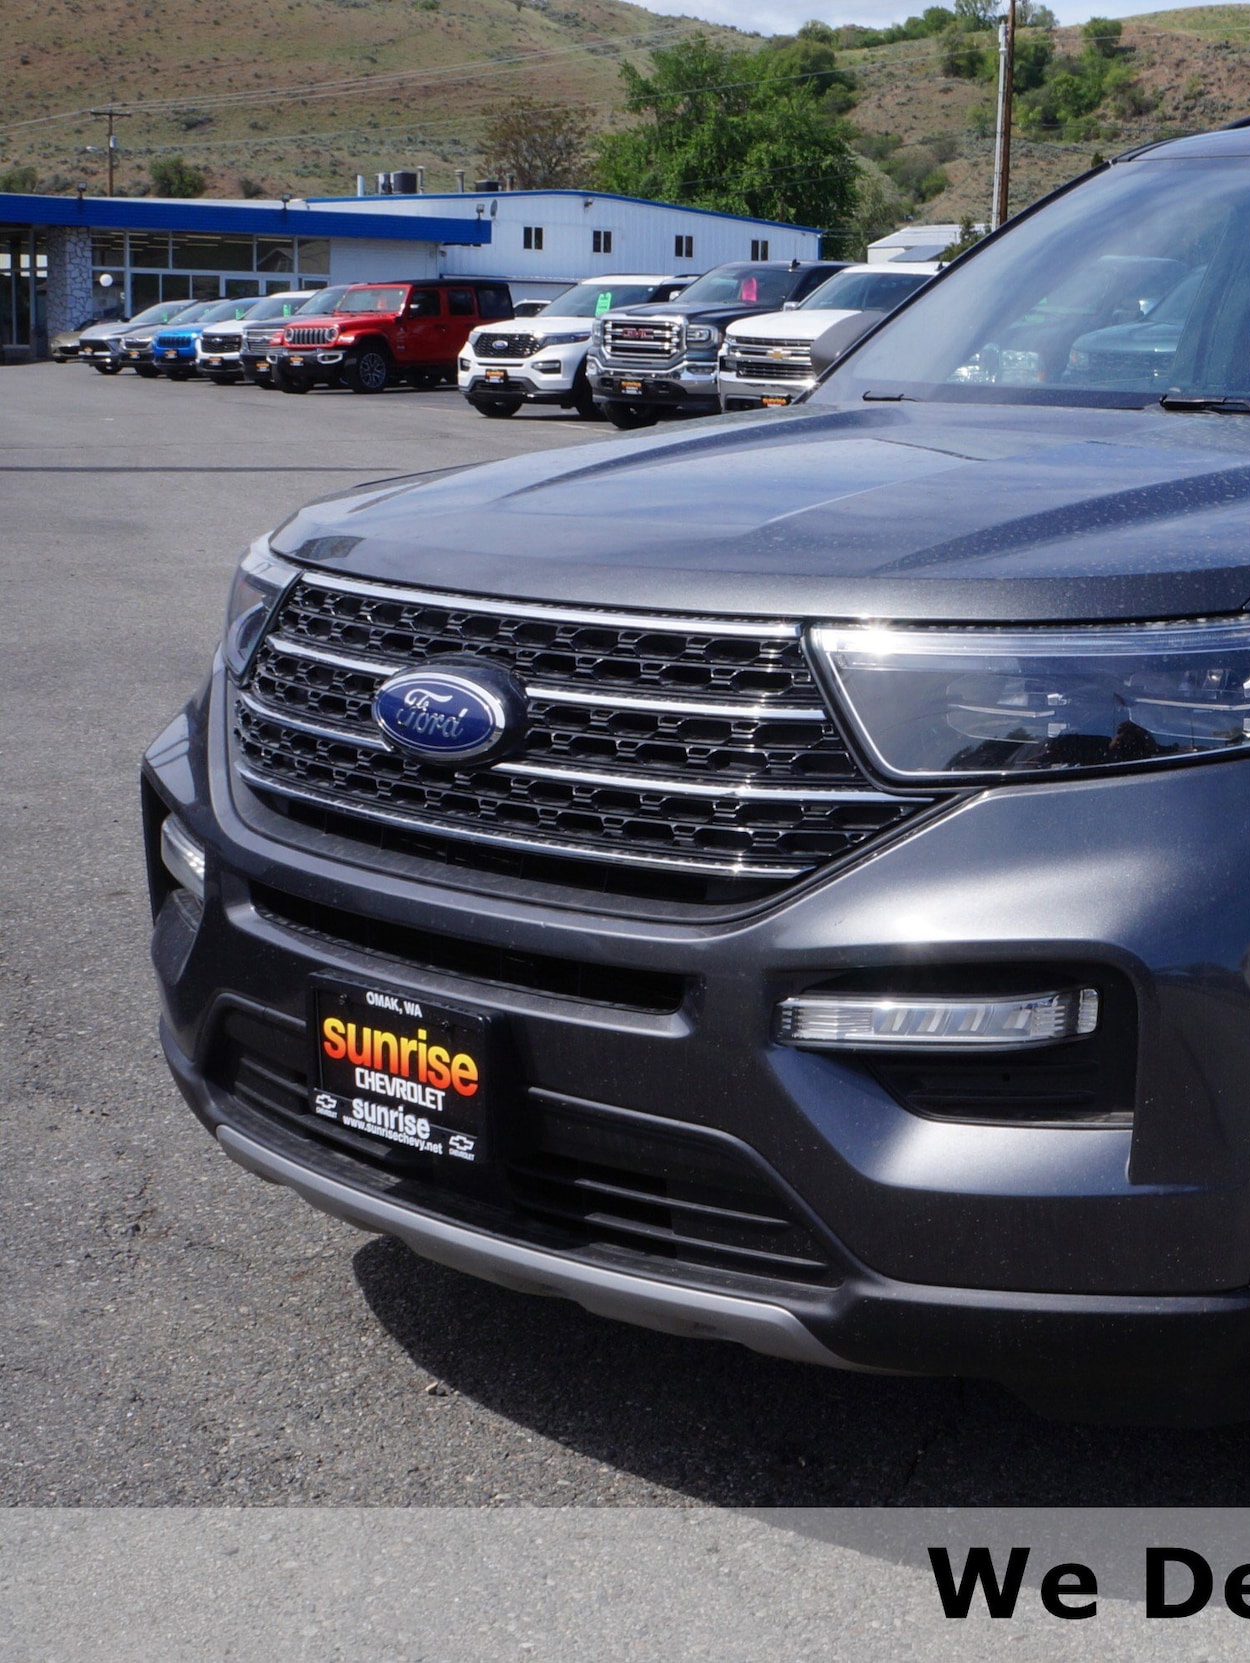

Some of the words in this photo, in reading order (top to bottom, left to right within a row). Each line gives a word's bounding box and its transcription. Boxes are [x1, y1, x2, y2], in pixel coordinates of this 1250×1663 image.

[396, 688, 469, 738] Ford
[366, 991, 403, 1015] OMAK,
[404, 1000, 423, 1018] WA
[323, 1017, 479, 1097] sunrise
[355, 1067, 446, 1112] CHEVROLET
[343, 1115, 444, 1155] www.sunrisechevy.net
[352, 1098, 431, 1140] sunrise
